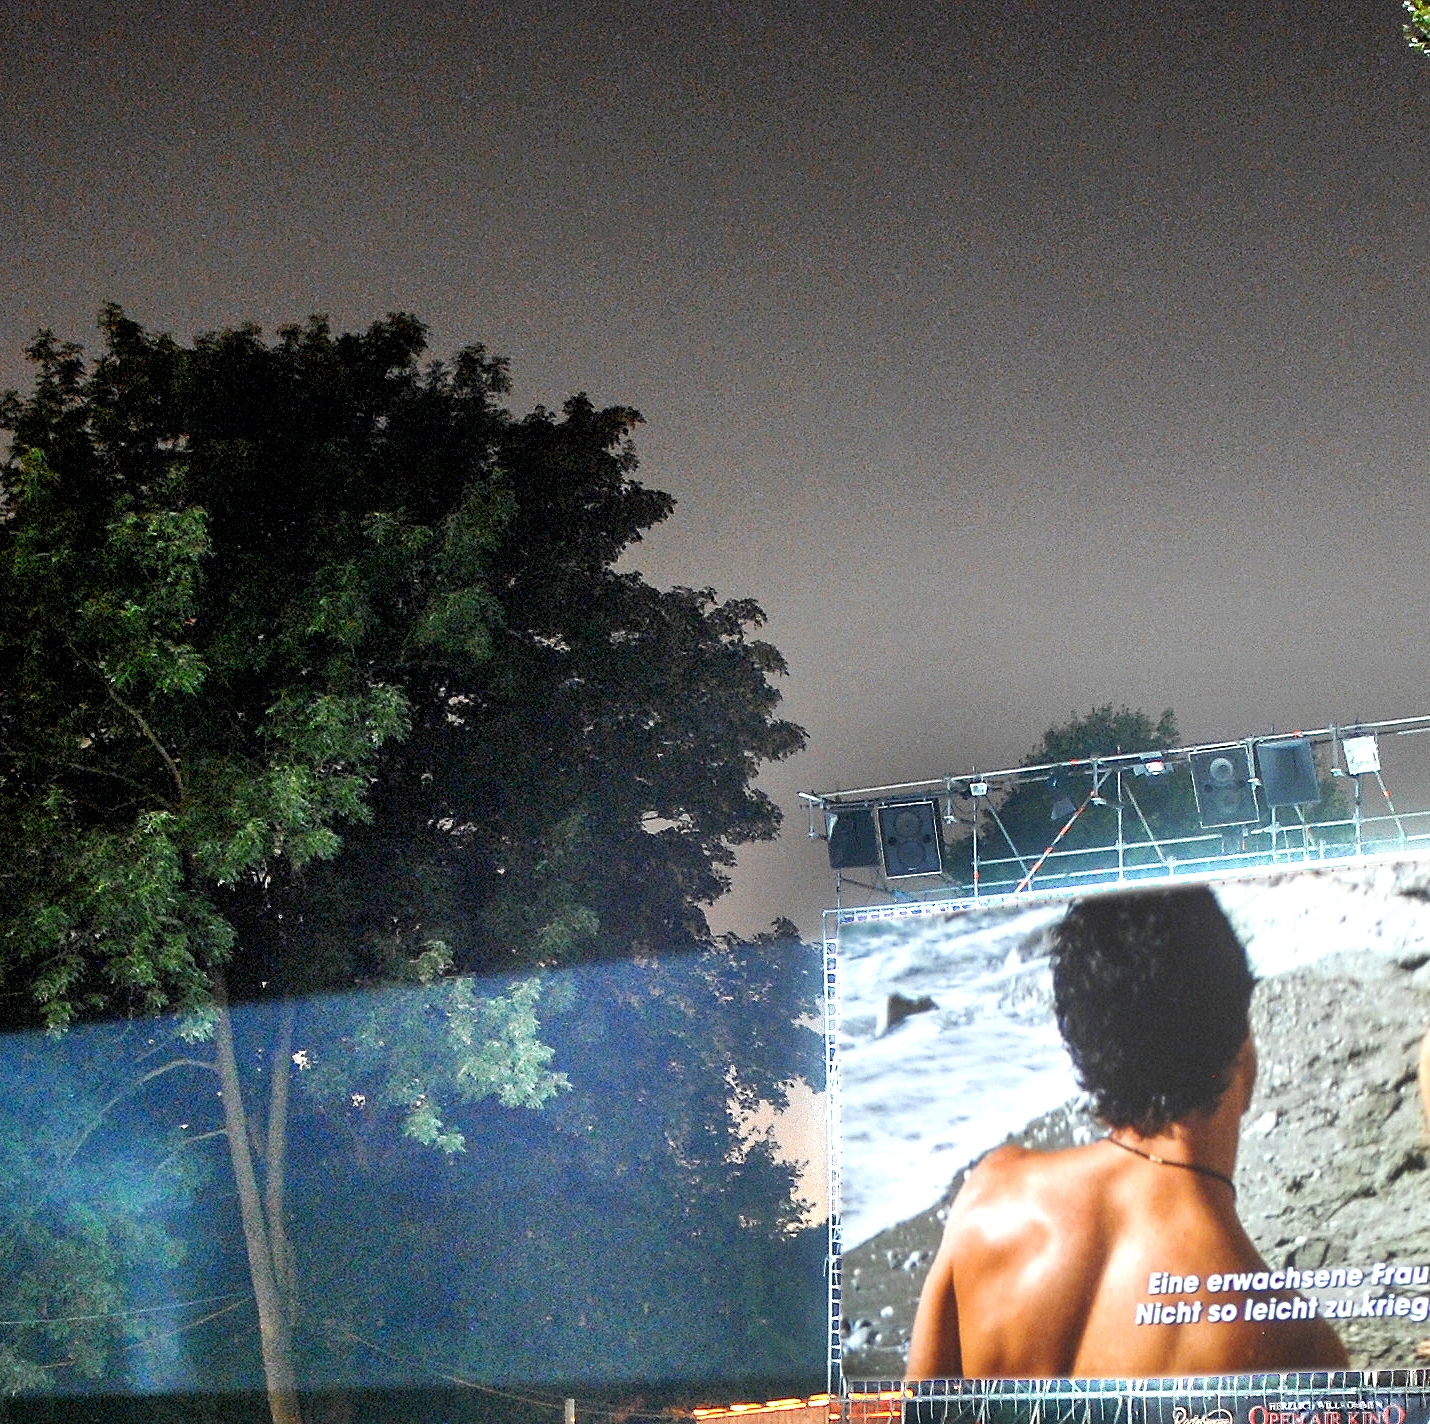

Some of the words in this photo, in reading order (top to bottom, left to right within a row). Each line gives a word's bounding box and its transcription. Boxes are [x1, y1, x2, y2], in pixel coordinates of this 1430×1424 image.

[1148, 1272, 1200, 1295] Eine
[1207, 1267, 1363, 1293] erwachsene
[1372, 1263, 1430, 1286] Frau
[1135, 1301, 1202, 1325] Nicht
[1207, 1303, 1238, 1322] so
[1244, 1297, 1319, 1321] leicht
[1324, 1299, 1354, 1318] zu
